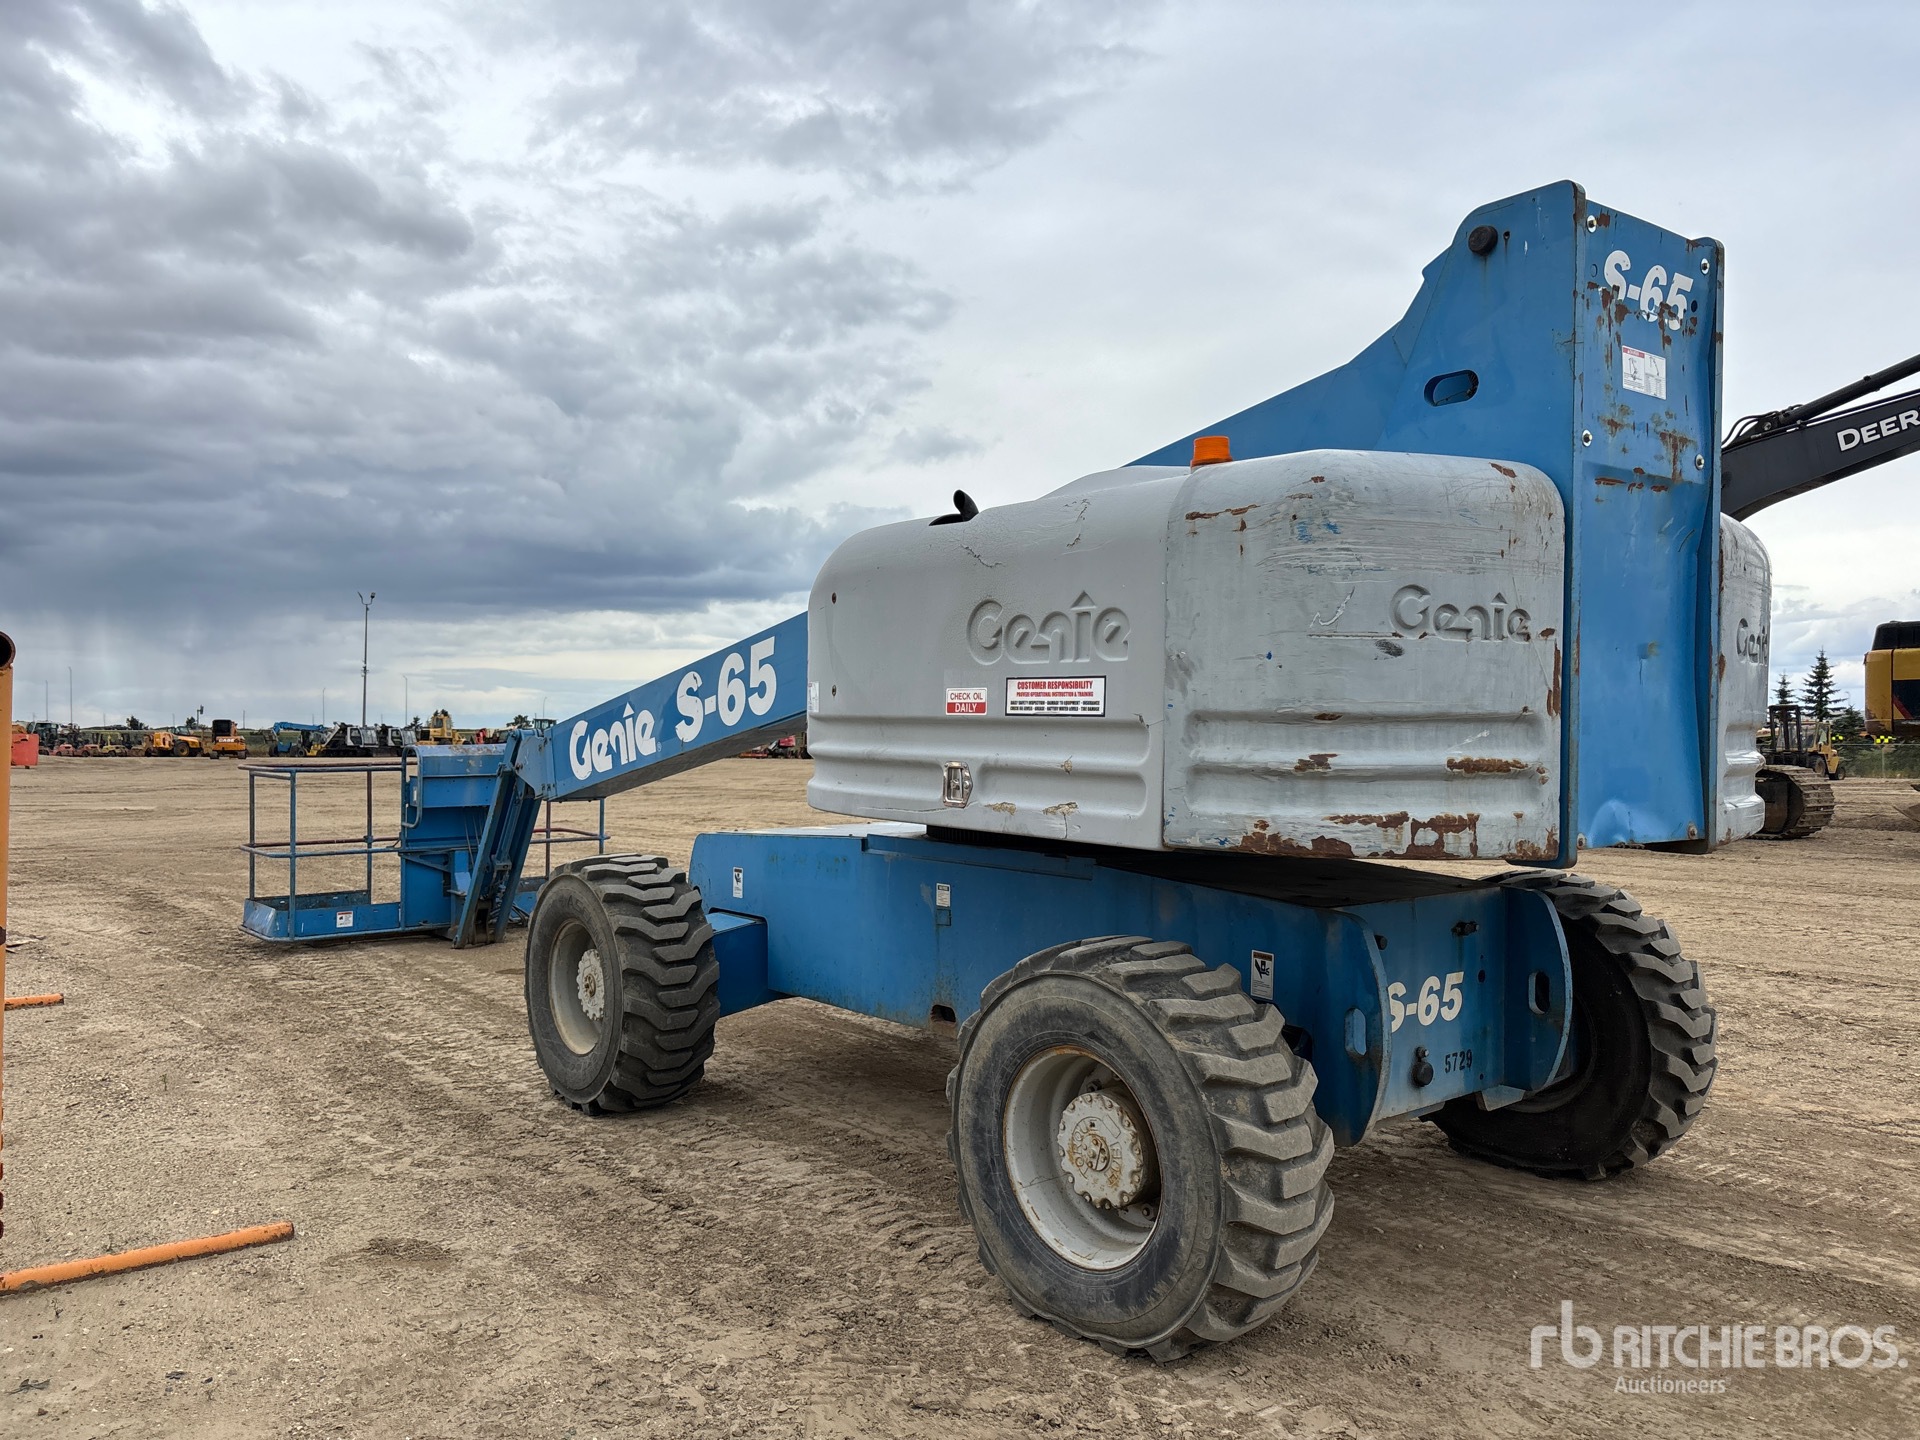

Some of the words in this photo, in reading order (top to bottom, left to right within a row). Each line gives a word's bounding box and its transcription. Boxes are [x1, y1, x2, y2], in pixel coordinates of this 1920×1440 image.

[1603, 250, 1694, 331] S-65
[1837, 409, 1920, 452] DEER
[966, 590, 1131, 666] Genie
[1389, 584, 1532, 644] Genie
[569, 702, 656, 781] Genie
[675, 636, 777, 743] S-65
[950, 692, 971, 701] CHECK
[973, 692, 984, 700] OIL
[955, 702, 978, 713] DAILY
[1017, 681, 1047, 690] CUSTOMER
[1047, 680, 1094, 690] RESPONSIBILITY
[1388, 971, 1464, 1033] S-65
[1445, 1049, 1473, 1074] 5729
